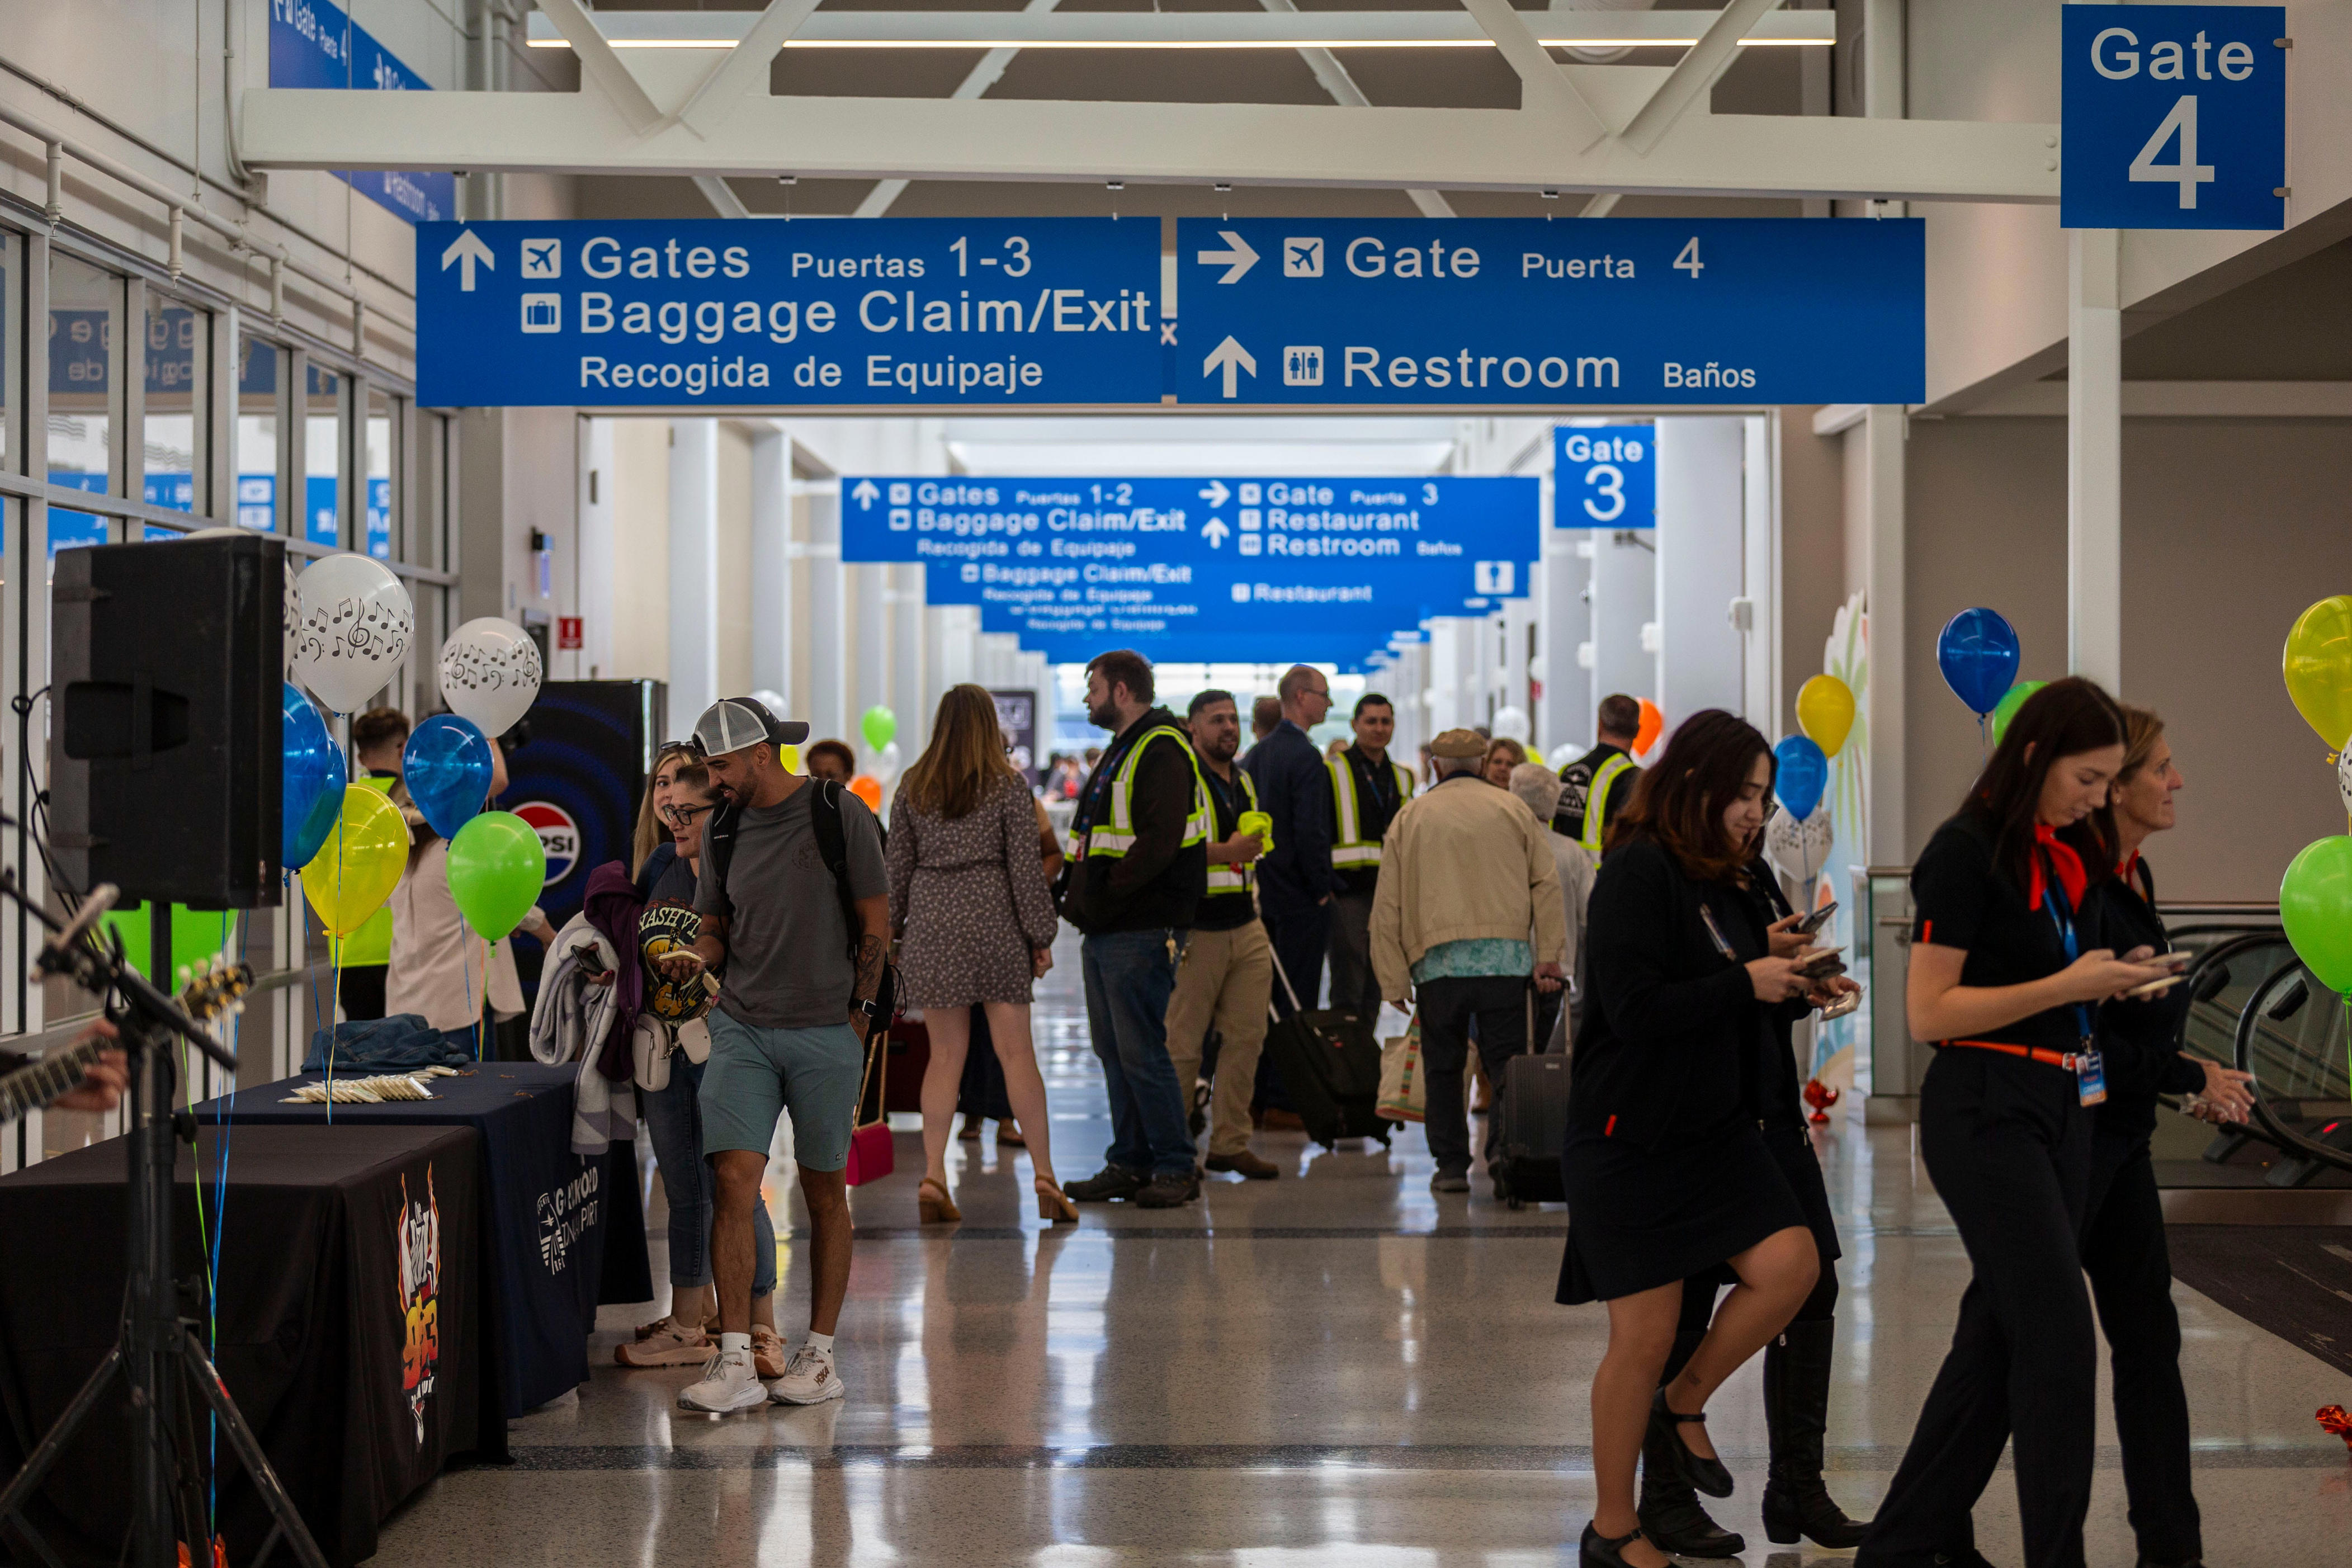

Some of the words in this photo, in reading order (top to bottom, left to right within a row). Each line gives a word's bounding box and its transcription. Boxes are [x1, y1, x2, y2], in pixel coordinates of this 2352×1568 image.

[2090, 27, 2254, 81] Gate
[2128, 95, 2215, 209] 4
[581, 237, 750, 279] Gates
[792, 253, 925, 278] Puertas
[950, 236, 1032, 277] 1-3
[1345, 237, 1480, 278] Gate
[1523, 253, 1635, 278] Puerta
[1673, 237, 1704, 278] 4
[580, 292, 835, 343] Baggage
[859, 289, 1151, 334] Claim/Exit
[581, 356, 769, 394] Recogida
[794, 356, 842, 387] de
[867, 355, 1042, 394] Equipaje
[1344, 346, 1619, 389] Restroom
[1664, 362, 1756, 388] Baños
[1566, 436, 1643, 462] Gate
[917, 483, 999, 506] Gates
[1016, 492, 1080, 505] Puertas
[1090, 484, 1133, 506] 1-2
[1268, 483, 1334, 506] Gate
[1350, 491, 1406, 505] Puerta
[1423, 484, 1438, 505] 3
[1583, 465, 1625, 521] 3
[917, 509, 1040, 535] Baggage
[1047, 508, 1186, 532] Claim/Exit
[1268, 509, 1419, 531] Restaurant
[917, 540, 1008, 558] Recogida
[1017, 541, 1042, 556] de
[1051, 539, 1136, 559] Equipaje
[1268, 534, 1400, 556] Restroom
[983, 564, 1078, 585] Baggage
[1083, 564, 1192, 583] Claim/Exit
[1253, 584, 1372, 602] Restaurant
[540, 835, 573, 852] PSI
[638, 906, 702, 938] NASHVI
[814, 1366, 830, 1387] HOKA
